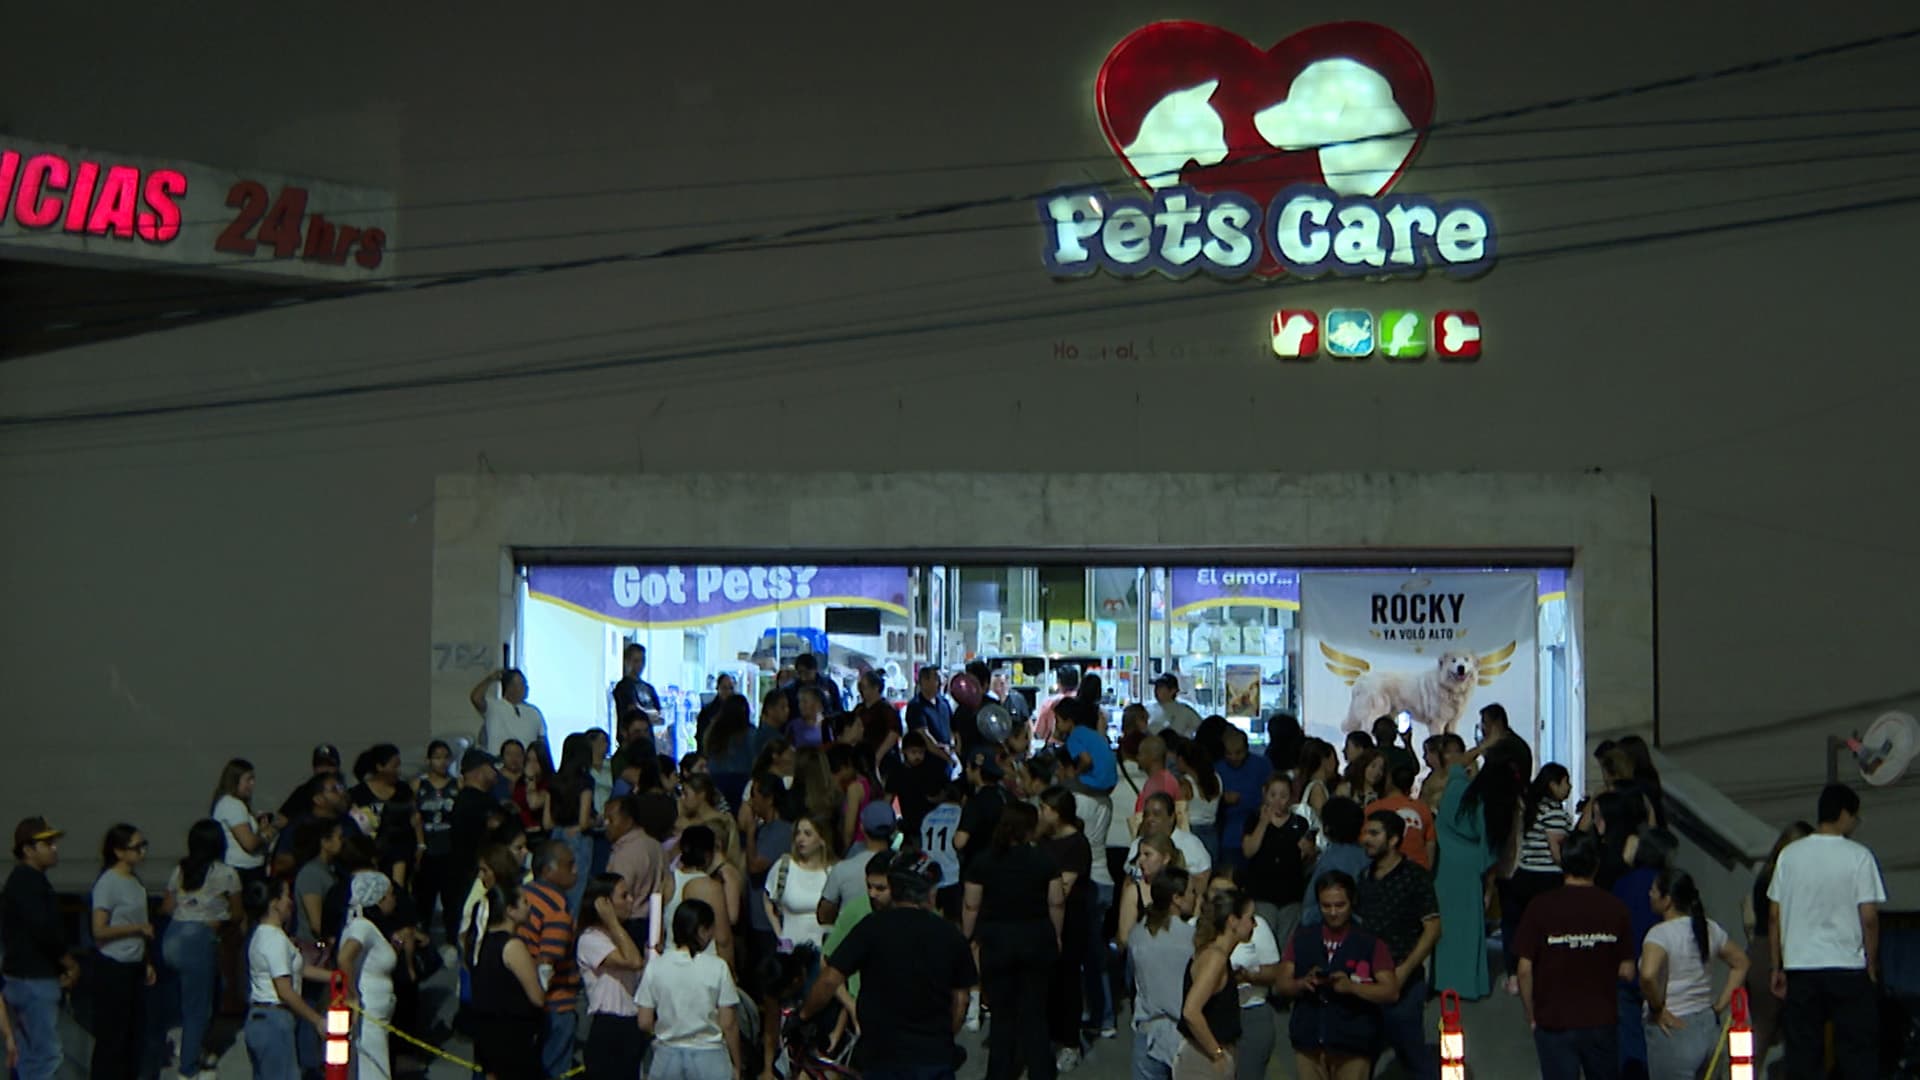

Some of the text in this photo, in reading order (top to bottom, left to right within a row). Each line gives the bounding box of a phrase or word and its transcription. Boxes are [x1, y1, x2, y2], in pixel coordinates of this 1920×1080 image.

[214, 180, 387, 270] 24hrs
[1048, 194, 1488, 267] Pets Care
[612, 567, 687, 608] Got
[1197, 568, 1217, 585] El
[1372, 594, 1465, 624] ROCKY
[1382, 628, 1454, 641] YA VOLÓ ALTO
[926, 826, 948, 851] 11
